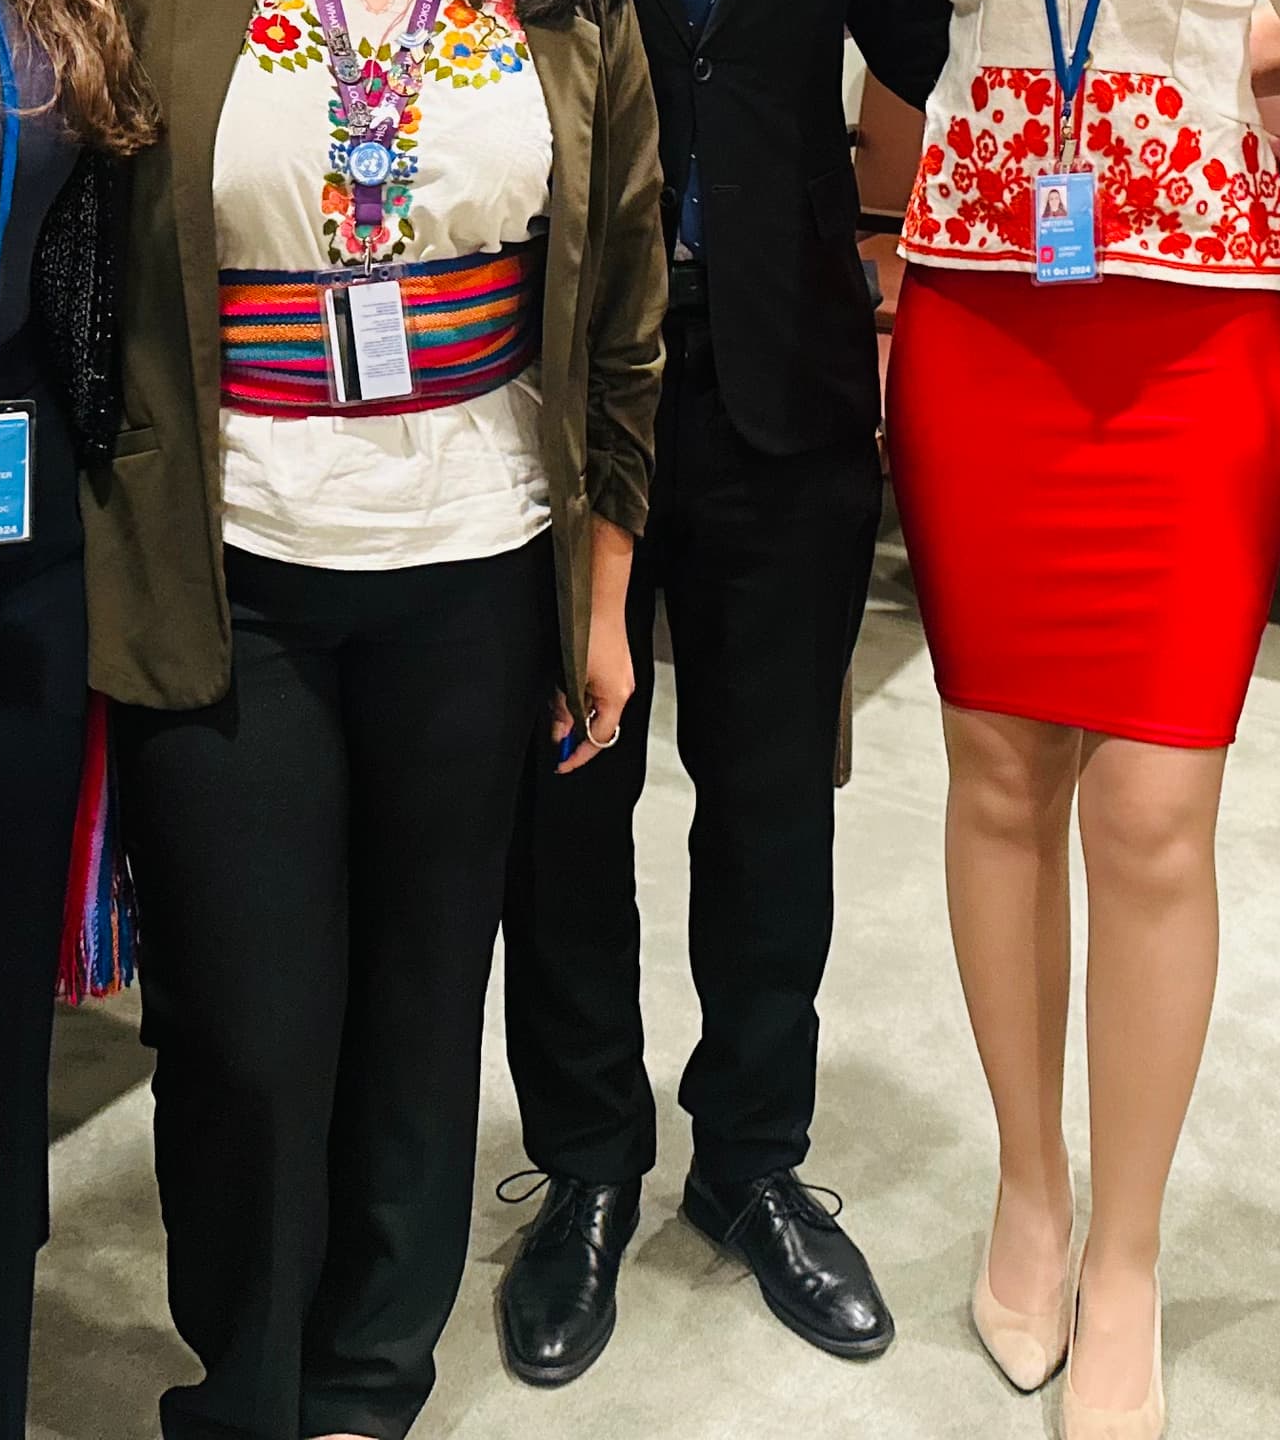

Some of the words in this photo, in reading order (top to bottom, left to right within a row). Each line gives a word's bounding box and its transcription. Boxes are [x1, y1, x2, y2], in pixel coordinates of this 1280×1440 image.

[324, 2, 340, 29] WHAT
[416, 3, 431, 30] OOKS
[373, 124, 388, 141] HIS
